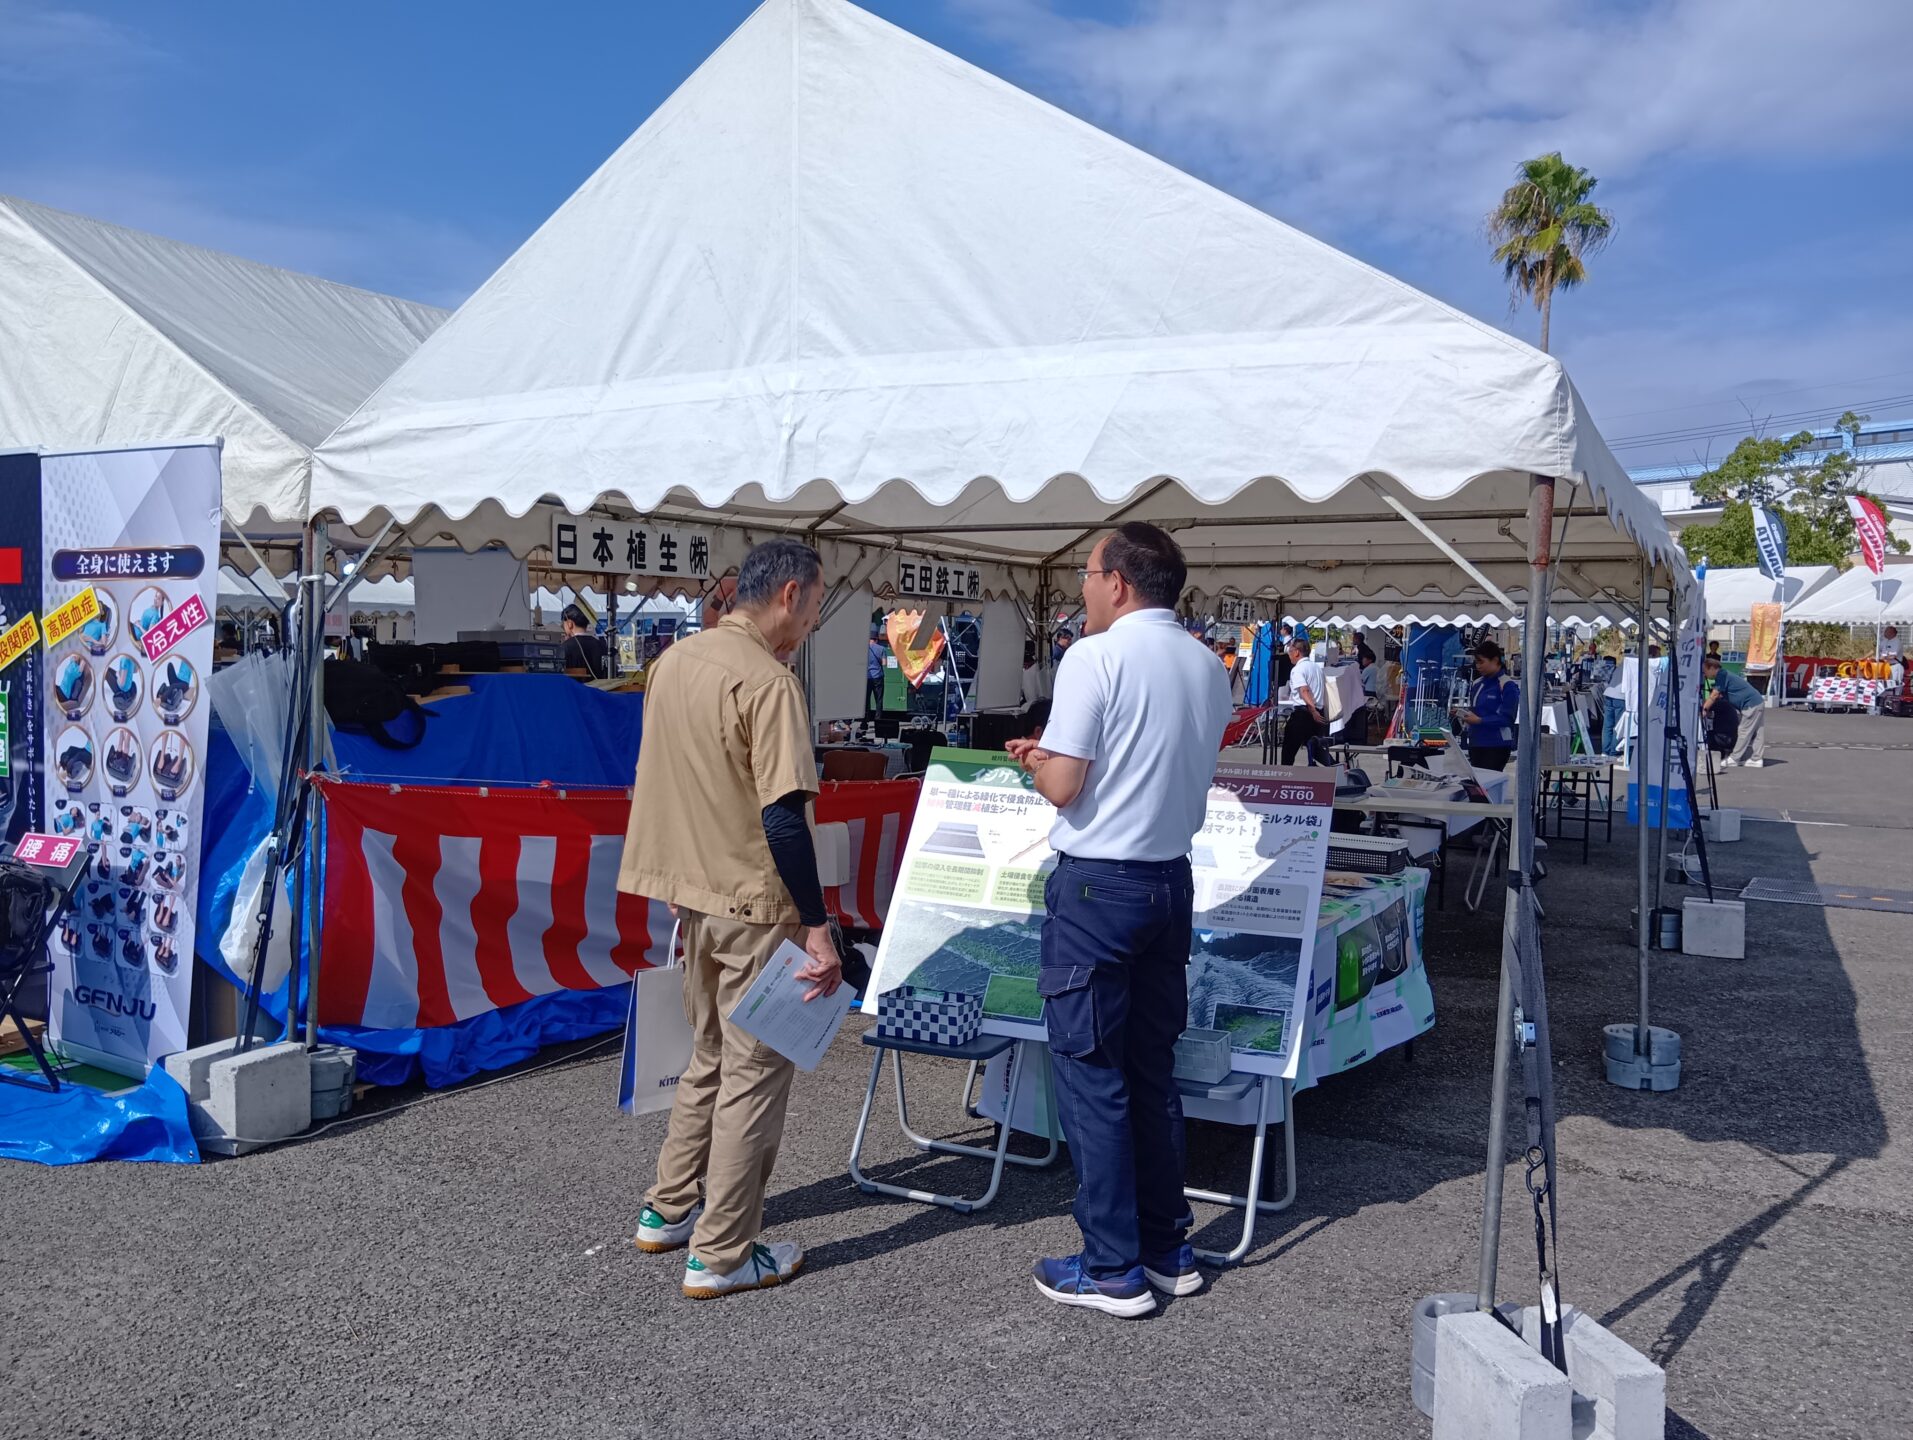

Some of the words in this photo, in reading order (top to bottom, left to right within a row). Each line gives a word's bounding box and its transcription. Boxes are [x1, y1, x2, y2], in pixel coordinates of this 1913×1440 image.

[76, 552, 174, 575] 全身に使えます
[46, 594, 96, 641] 高脂血症
[147, 598, 203, 655] 冷え性
[1279, 789, 1314, 801] ST60
[20, 838, 73, 863] 腰痛
